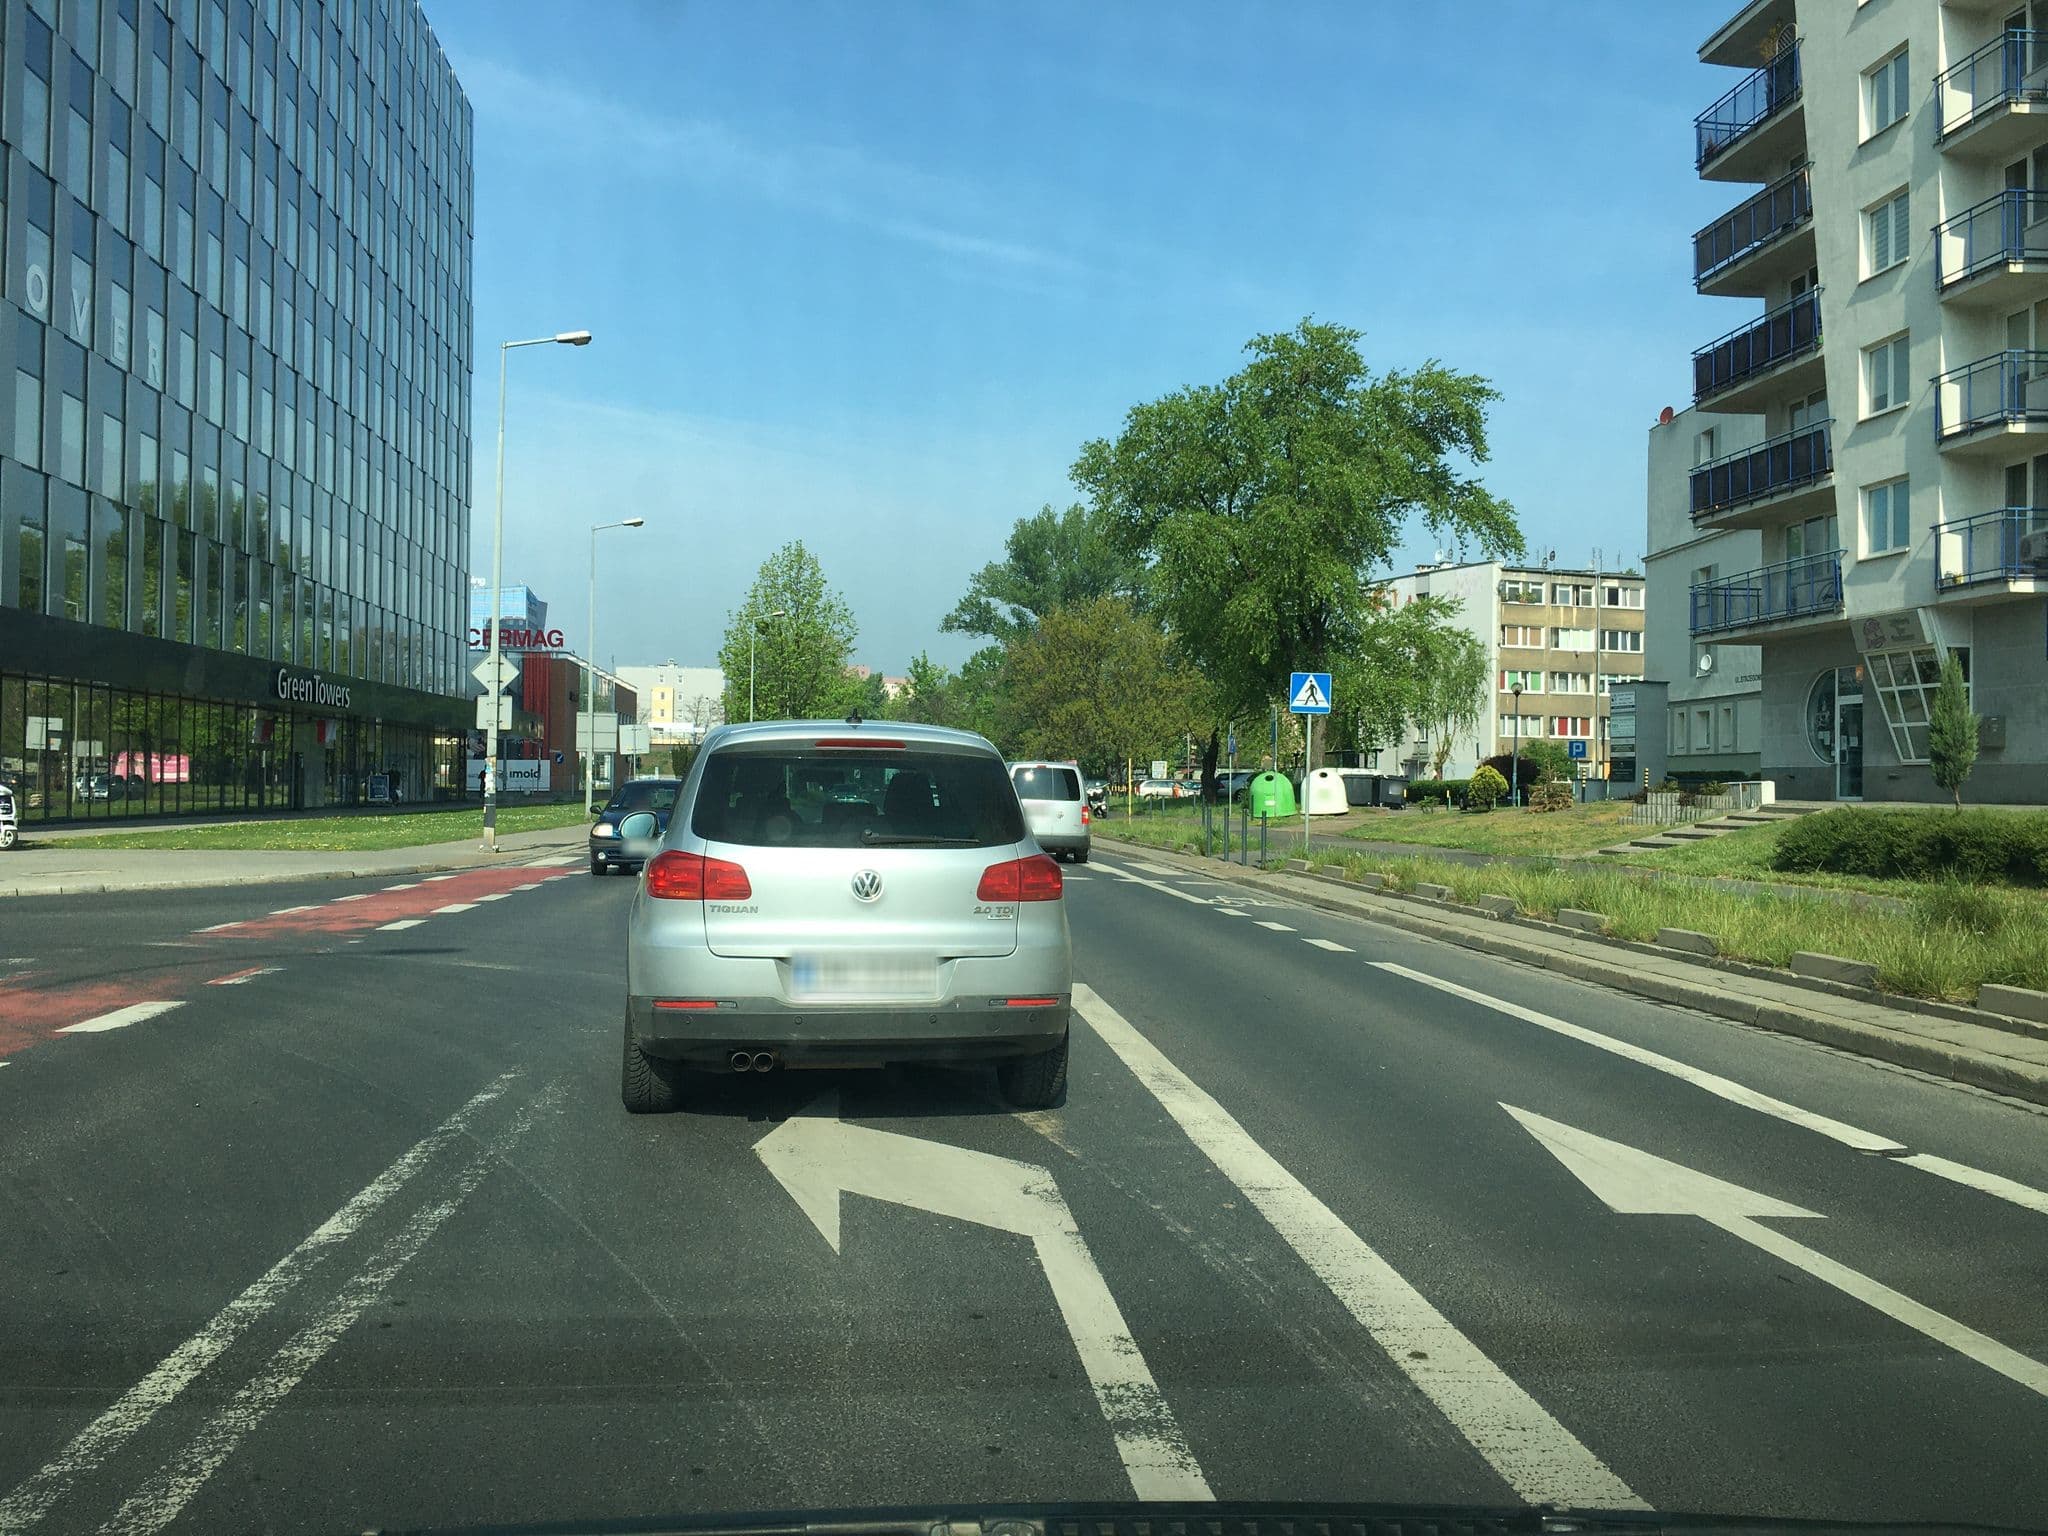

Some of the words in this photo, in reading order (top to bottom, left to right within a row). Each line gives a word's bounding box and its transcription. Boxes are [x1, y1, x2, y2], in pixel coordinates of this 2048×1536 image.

[278, 668, 313, 702] Green
[313, 674, 350, 708] Towers
[709, 905, 759, 914] TIGUAN
